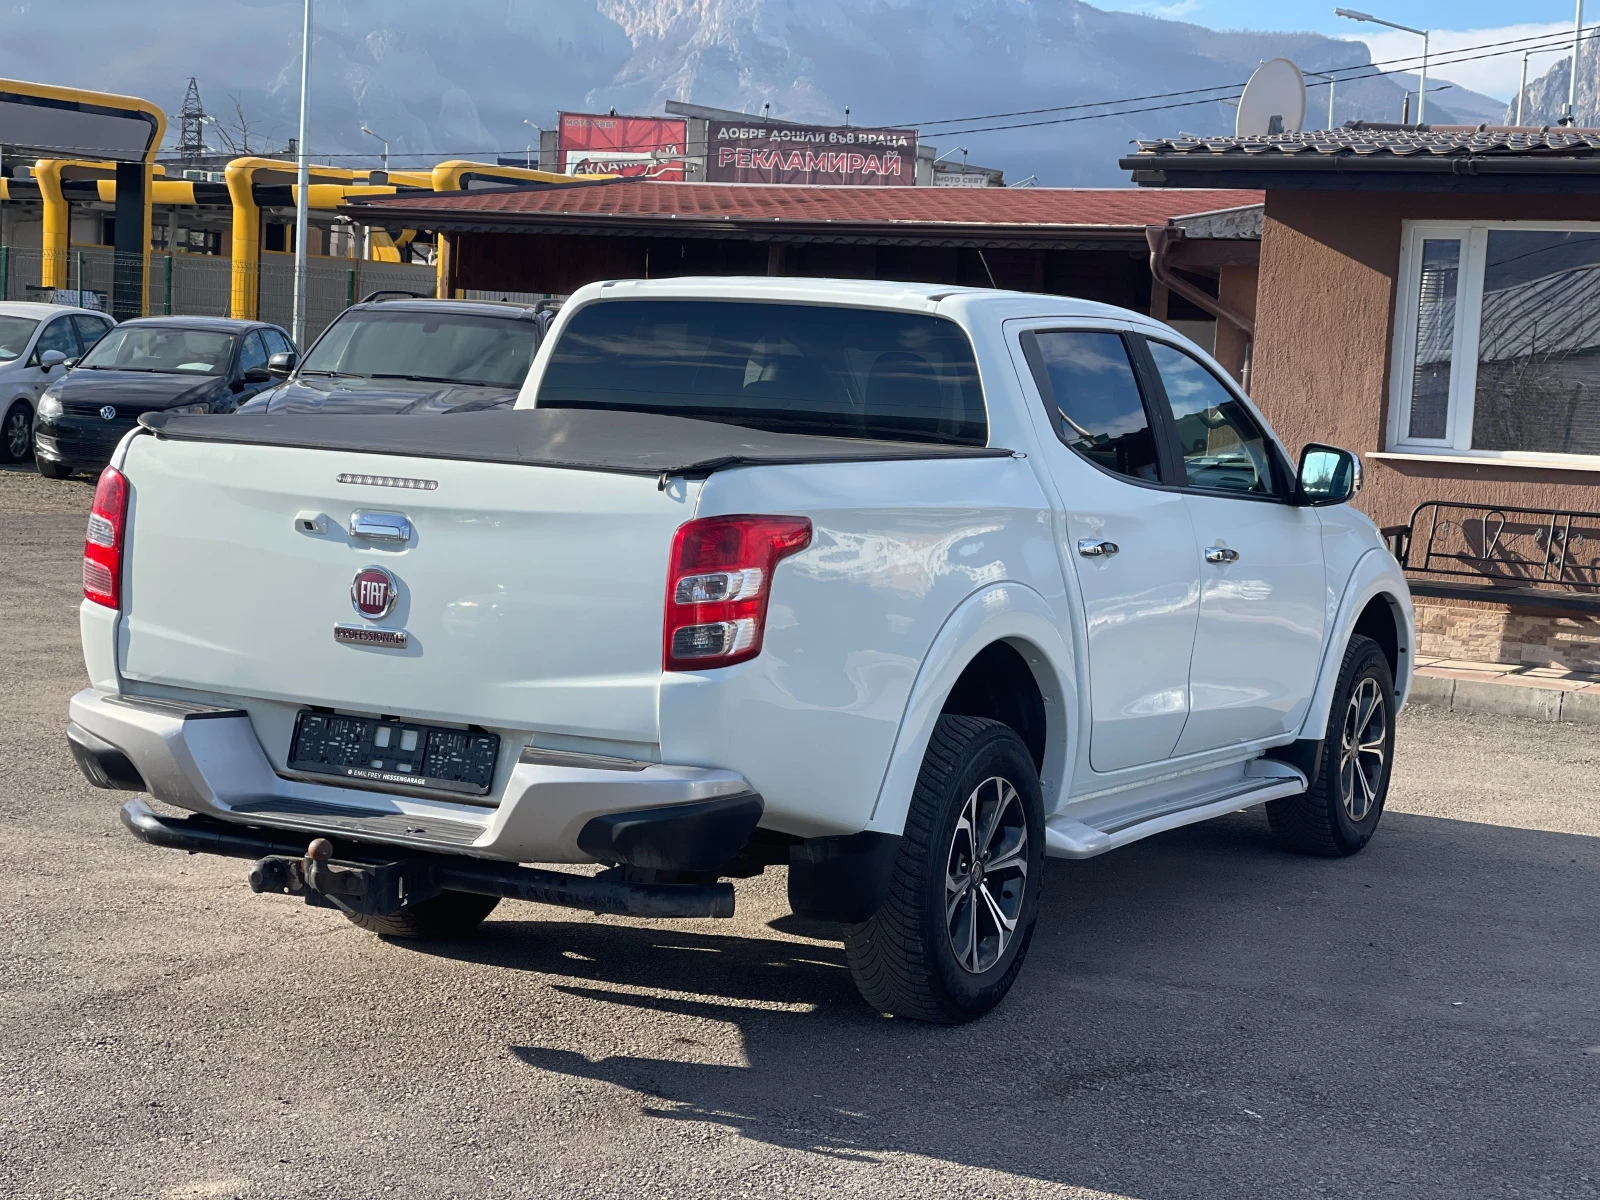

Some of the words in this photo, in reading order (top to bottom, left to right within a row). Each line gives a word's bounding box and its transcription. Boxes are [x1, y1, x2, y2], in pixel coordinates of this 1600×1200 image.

[565, 119, 592, 127] МОТО
[717, 127, 767, 140] ДОБРЕ
[769, 129, 825, 142] ДОШЛИ
[858, 133, 908, 148] ВРАЦА
[718, 147, 901, 176] РЕКЛАМИРАЙ
[360, 580, 387, 607] FIAT
[337, 628, 402, 644] PROFESSIONAL
[354, 769, 367, 777] EMIL
[382, 773, 426, 785] HESSENGARAGE
